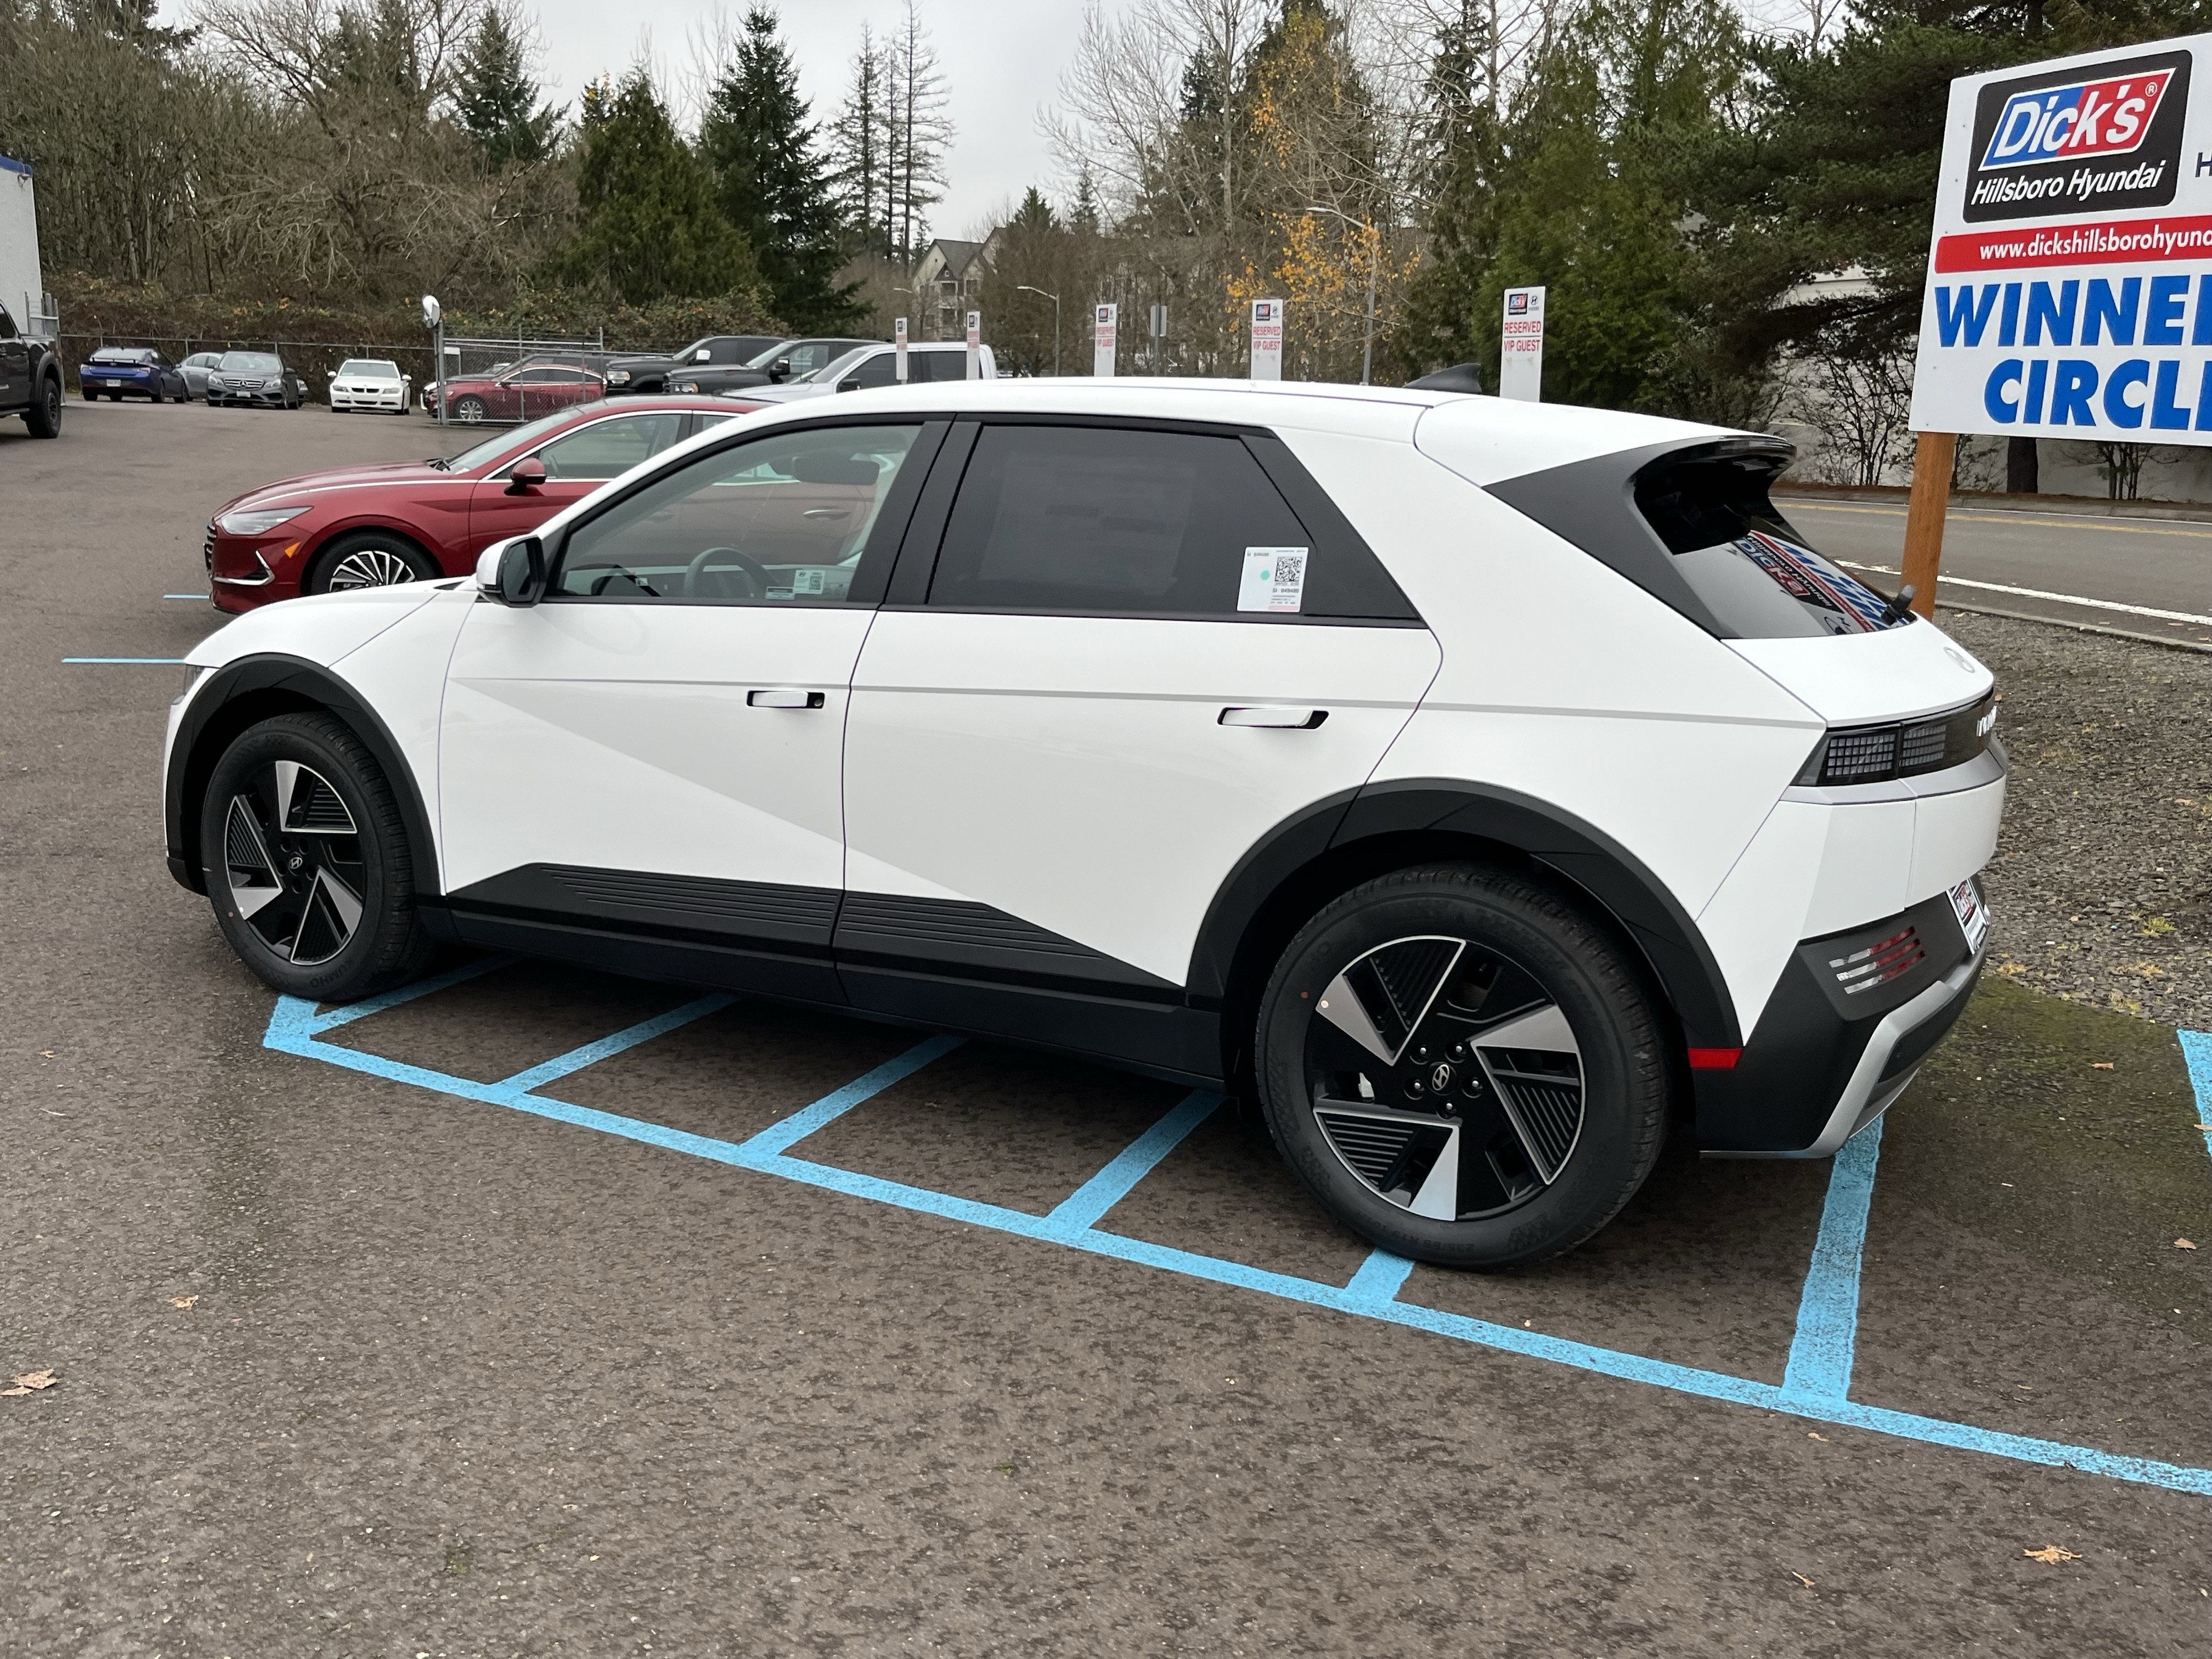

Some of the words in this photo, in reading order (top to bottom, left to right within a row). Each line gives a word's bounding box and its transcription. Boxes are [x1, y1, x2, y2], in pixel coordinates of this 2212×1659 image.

[1993, 84, 2146, 159] Dick's
[1971, 175, 2064, 205] Hillsboro
[2066, 160, 2166, 201] Hyundai
[1253, 326, 1281, 336] RESERVED
[1504, 321, 1541, 334] RESERVED
[1262, 340, 1280, 351] GUEST
[1504, 340, 1515, 352] VIP
[1516, 340, 1540, 352] GUEST
